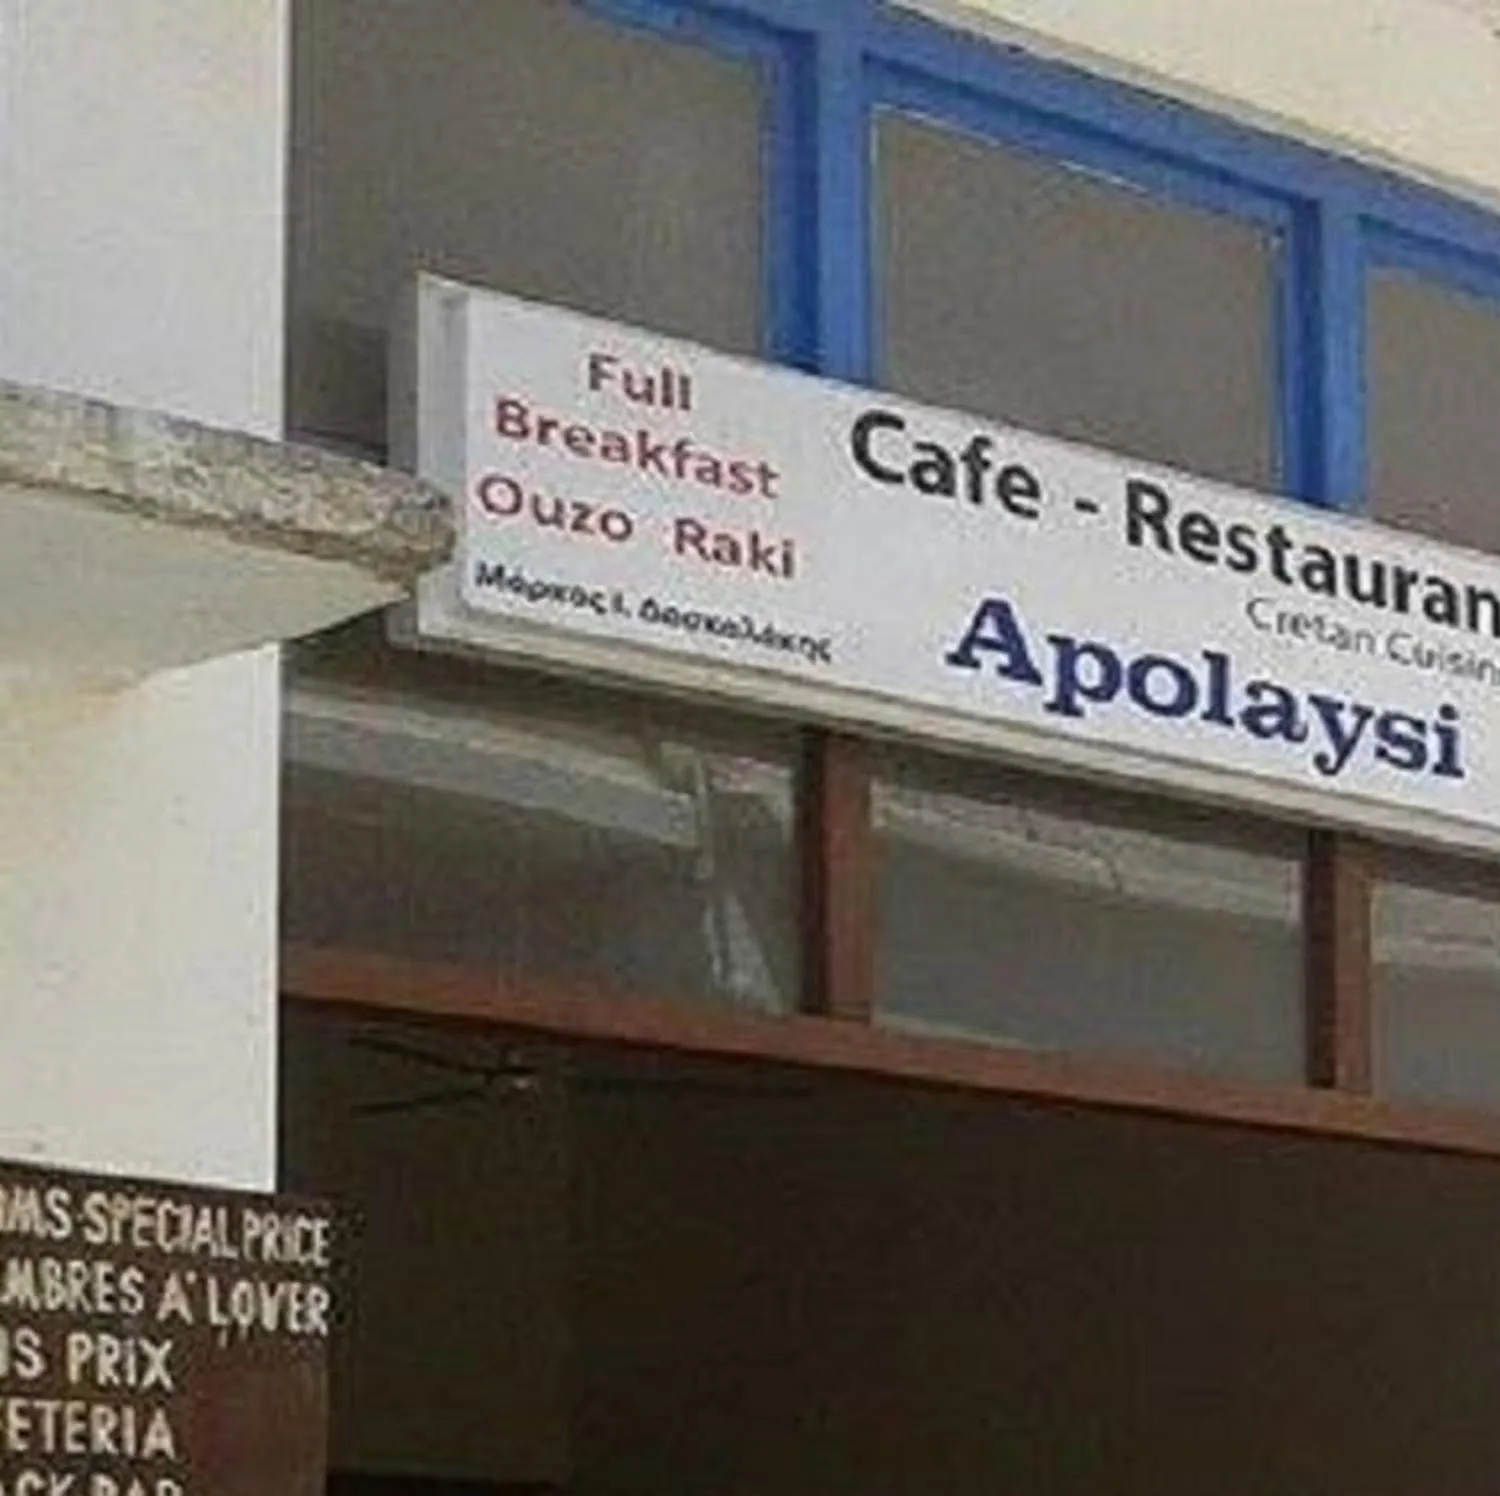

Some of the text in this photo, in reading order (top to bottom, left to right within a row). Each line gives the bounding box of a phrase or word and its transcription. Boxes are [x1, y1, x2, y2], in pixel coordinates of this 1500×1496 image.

[587, 353, 693, 411] Full
[494, 398, 781, 499] Breakfast
[851, 408, 1042, 519] Cafe
[476, 474, 796, 580] Ouzo Raki
[1246, 596, 1376, 656] Cretan
[945, 598, 1465, 780] Apolaysi
[83, 1191, 239, 1261] SPECIAL
[243, 1208, 331, 1268] PRICE
[0, 1257, 145, 1315] MBRES
[66, 1330, 174, 1392] PRIX
[7, 1397, 177, 1460] ETERIA
